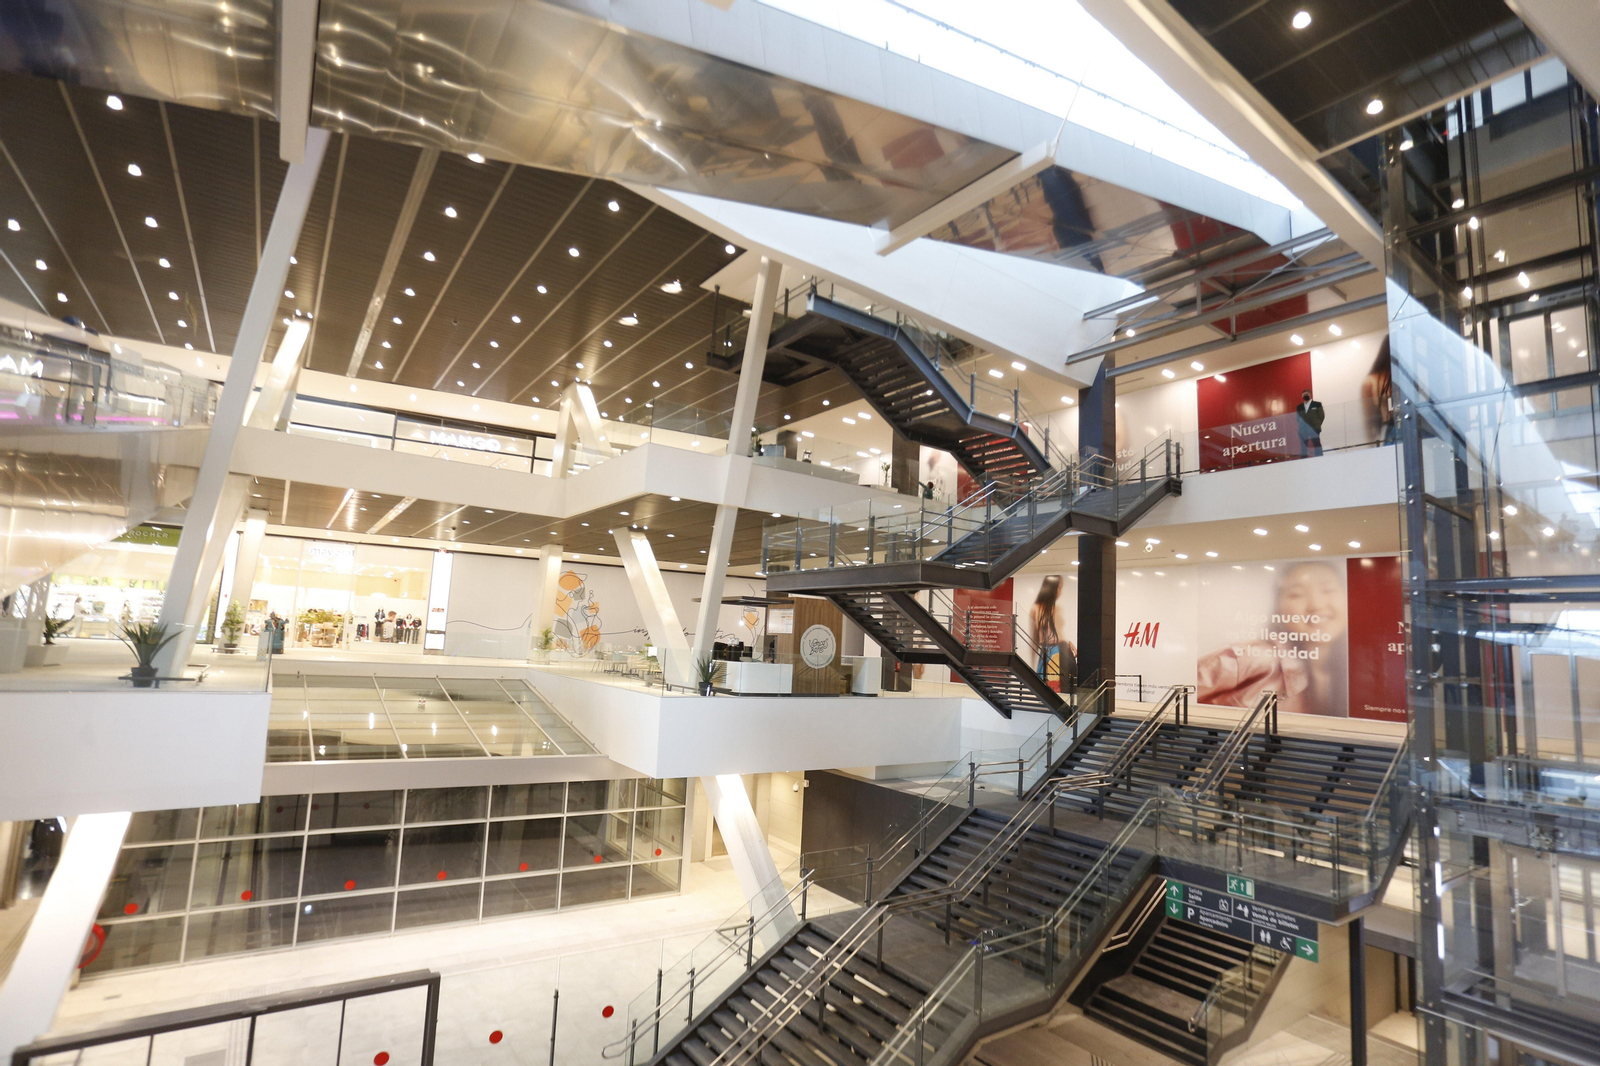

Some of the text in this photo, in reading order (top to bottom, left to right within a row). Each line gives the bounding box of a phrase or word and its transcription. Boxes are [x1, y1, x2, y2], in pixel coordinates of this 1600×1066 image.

[1230, 421, 1277, 438] Nueva
[430, 430, 501, 452] MANGO
[1222, 437, 1287, 458] apertura
[129, 530, 169, 539] ROCHER
[1233, 611, 1321, 626] Algo nuevo
[1124, 622, 1160, 649] H&M
[1224, 628, 1332, 644] está llegando
[1234, 644, 1319, 660] a la ciudad
[1364, 704, 1391, 713] Siempre
[1187, 907, 1195, 919] P
